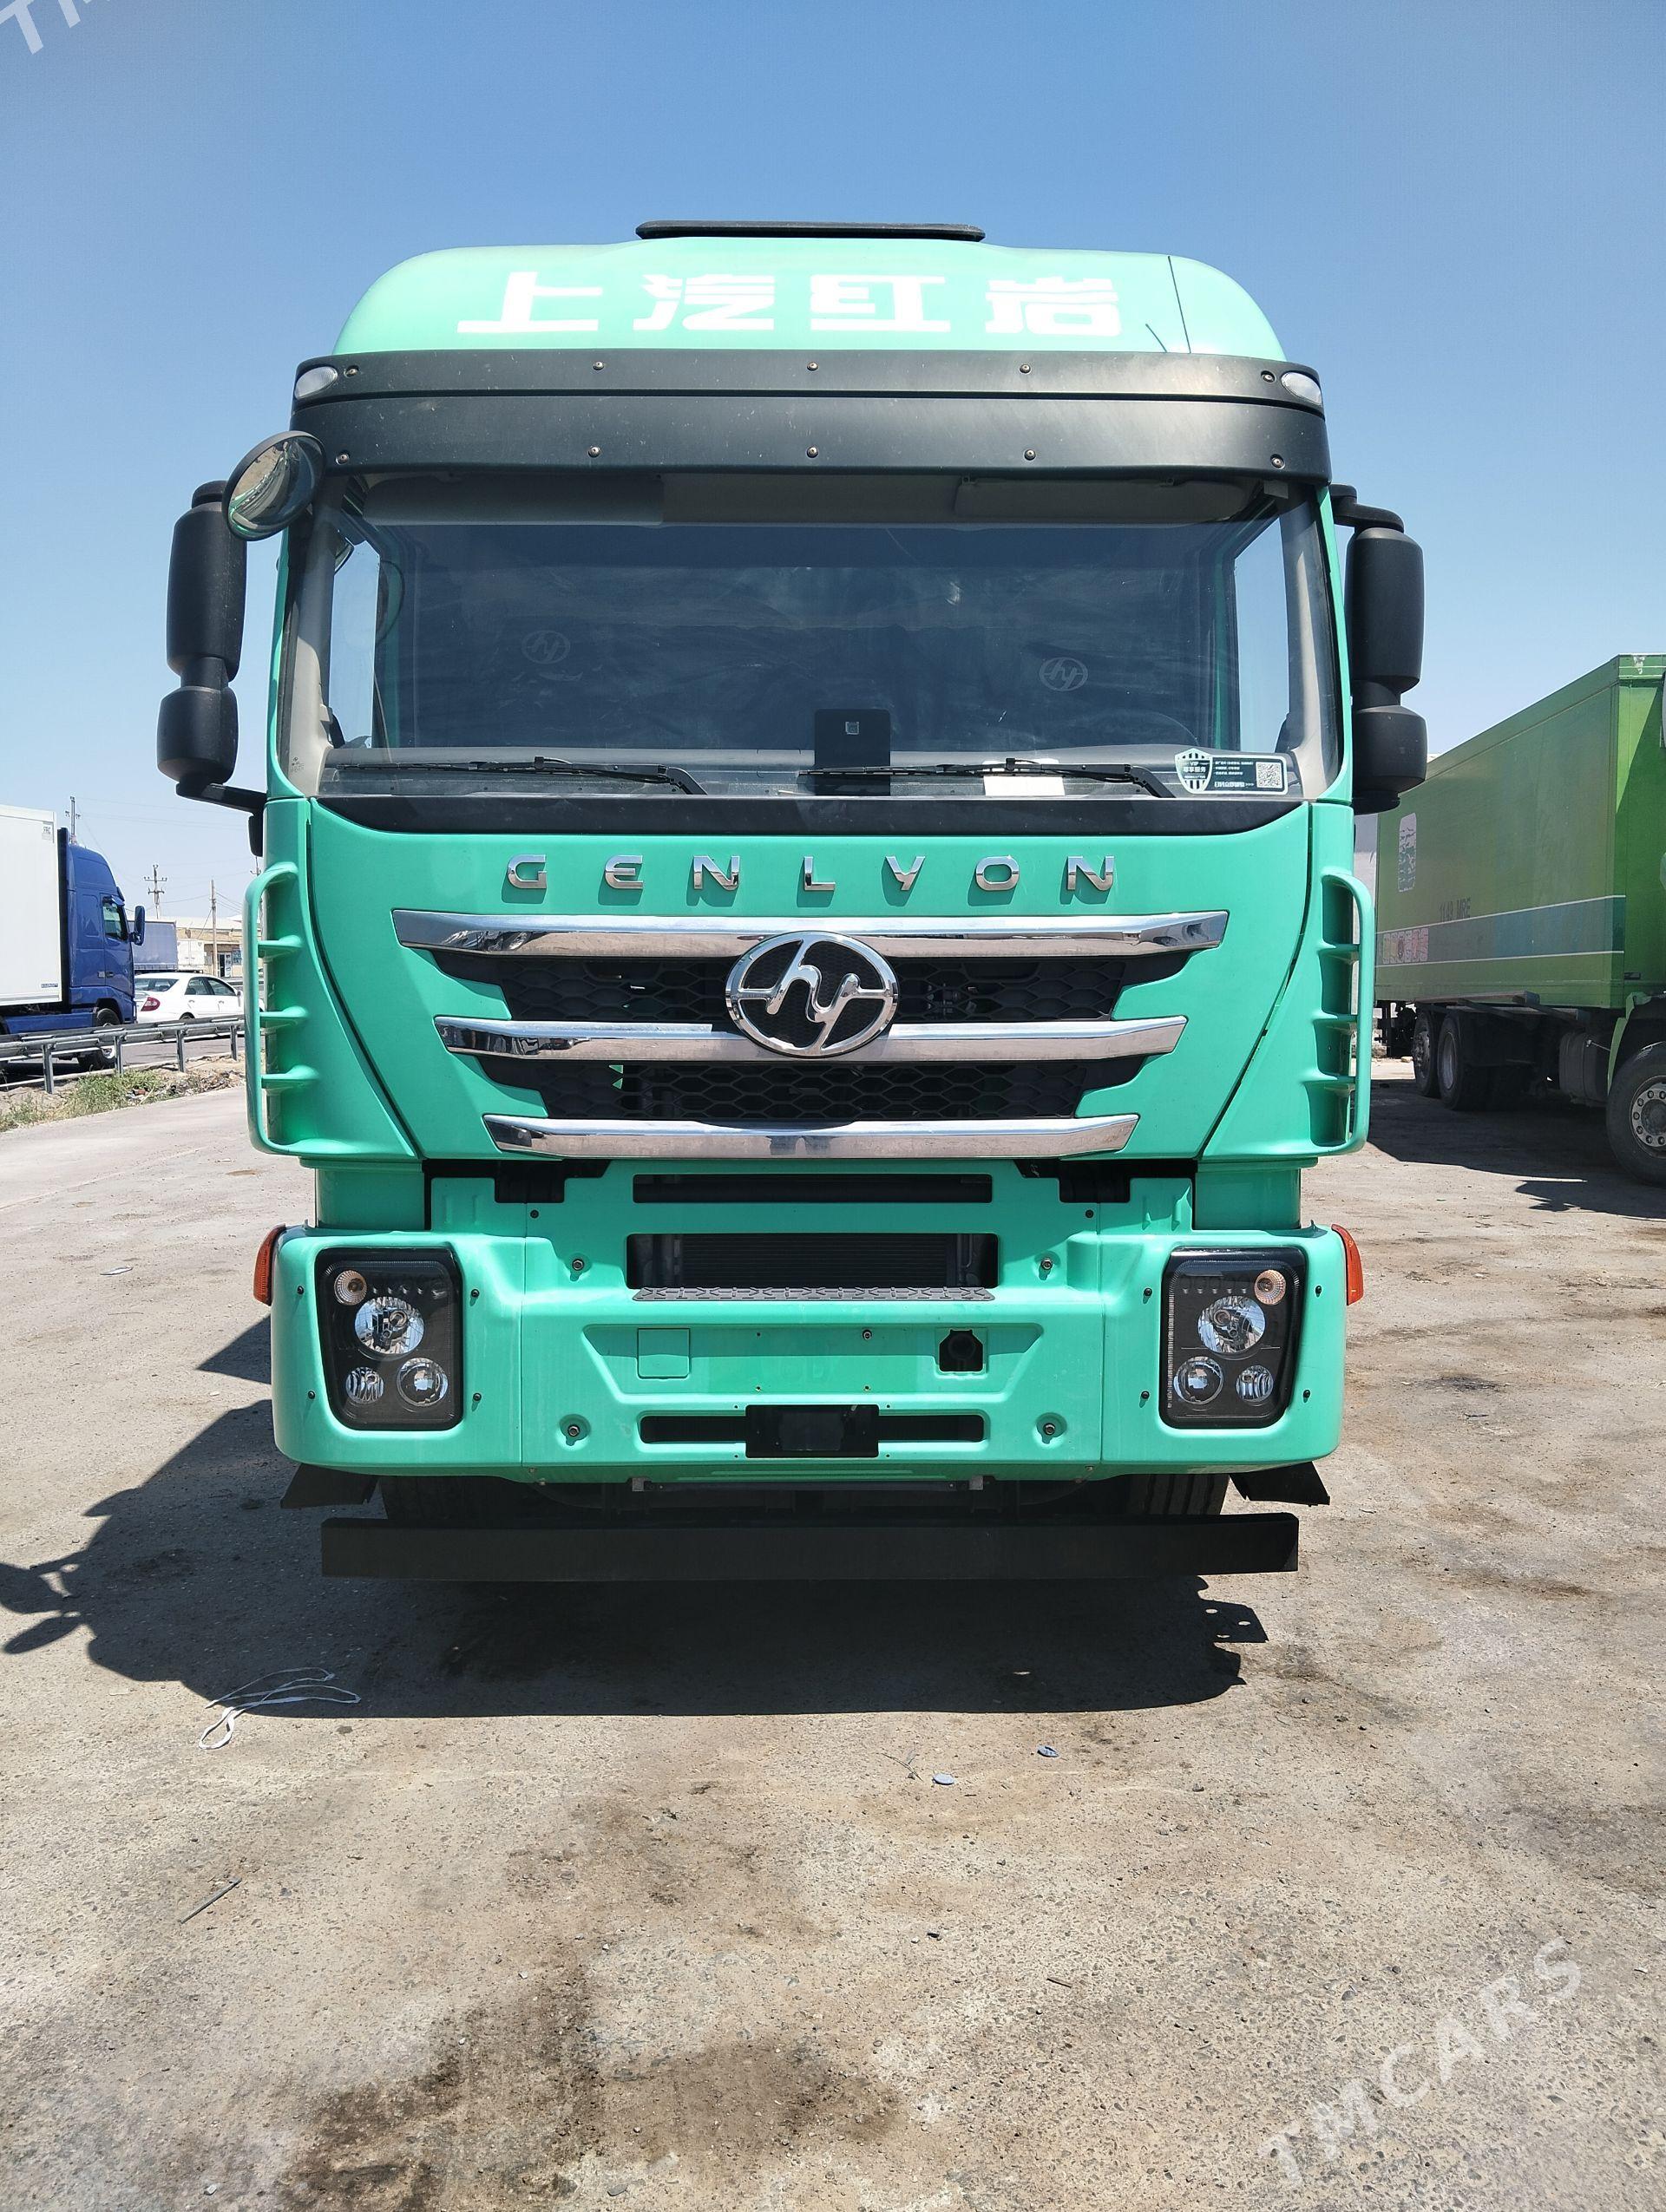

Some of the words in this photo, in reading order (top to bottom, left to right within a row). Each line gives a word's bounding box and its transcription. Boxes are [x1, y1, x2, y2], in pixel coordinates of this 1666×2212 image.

[456, 270, 1123, 337] 上汽红岩
[507, 854, 1115, 893] GENLYON
